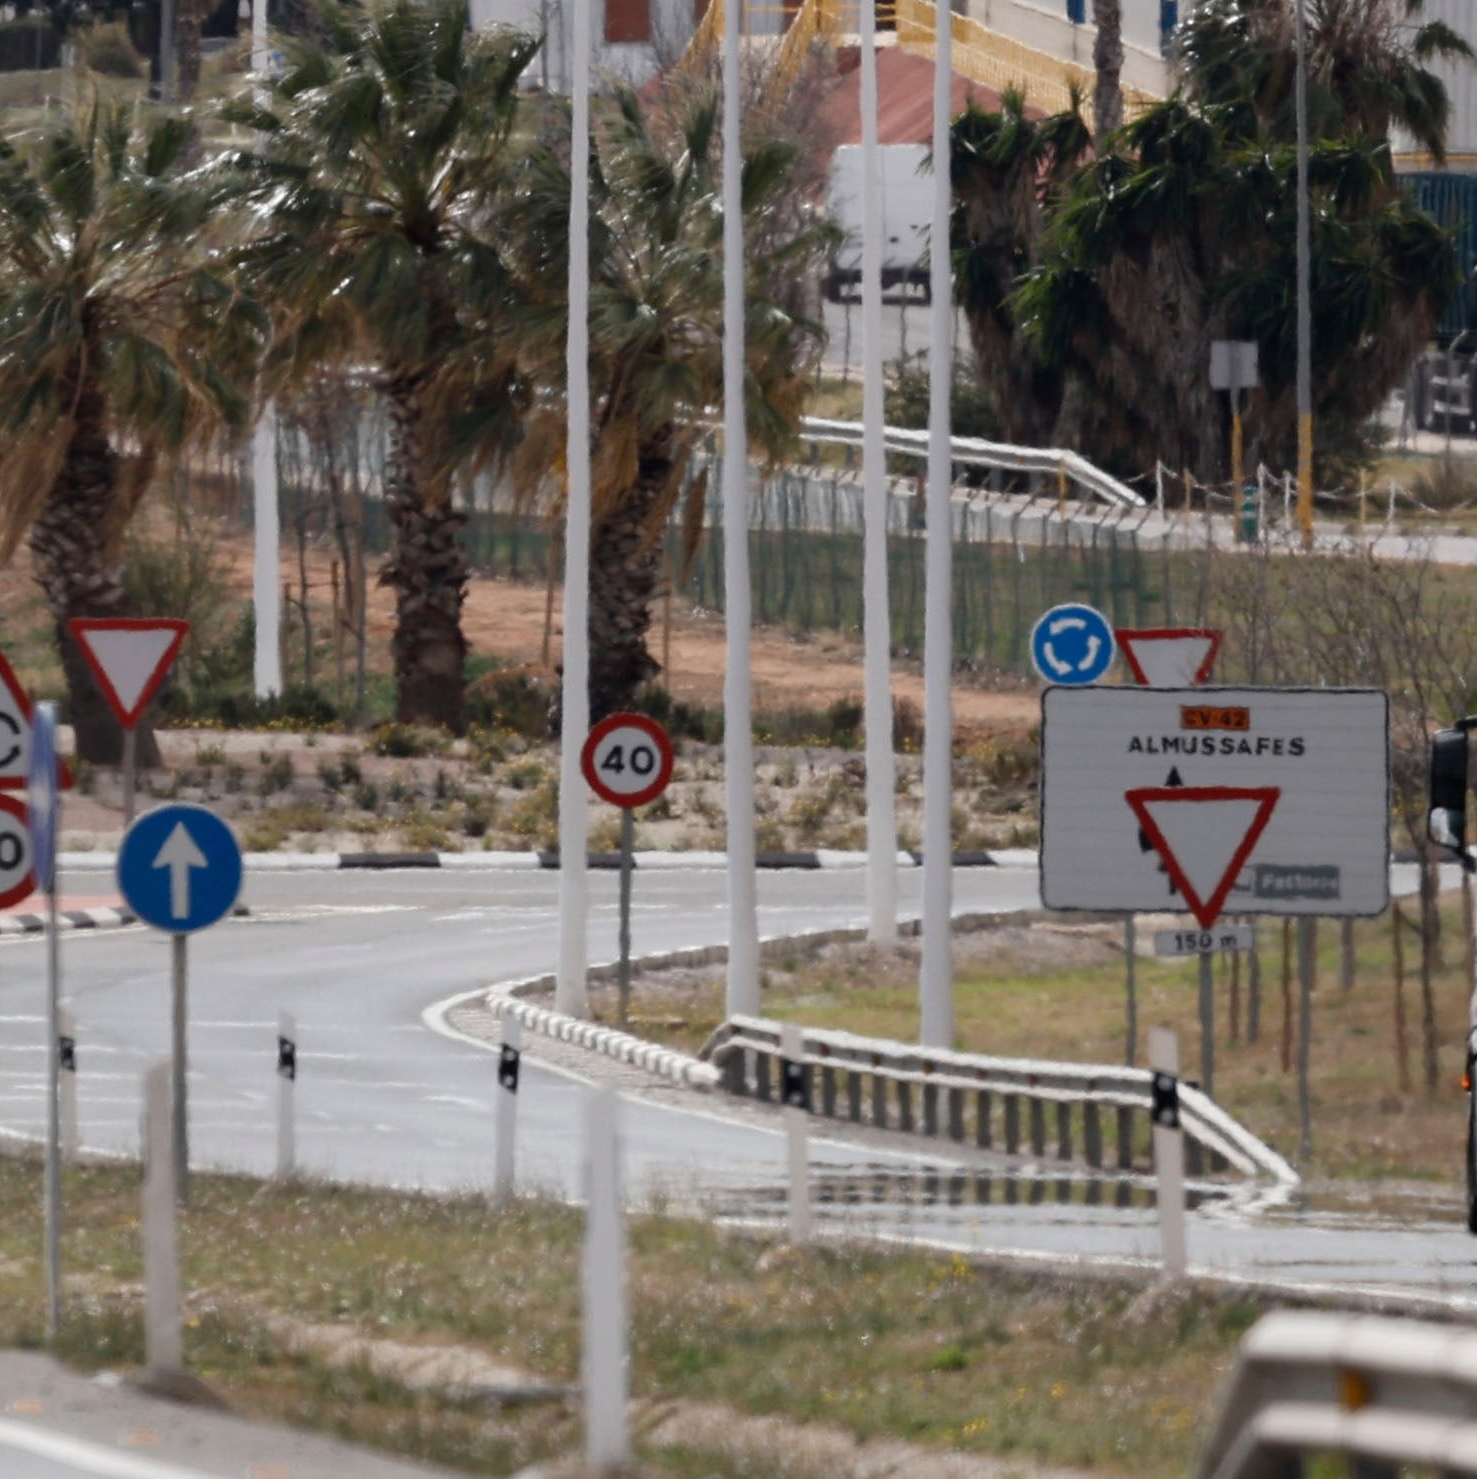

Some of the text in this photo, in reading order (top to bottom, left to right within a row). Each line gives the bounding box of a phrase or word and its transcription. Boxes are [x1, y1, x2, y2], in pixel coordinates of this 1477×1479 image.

[1127, 735, 1306, 757] ALMUSSAFES
[601, 744, 655, 776] 40
[1174, 931, 1239, 952] 150 m
